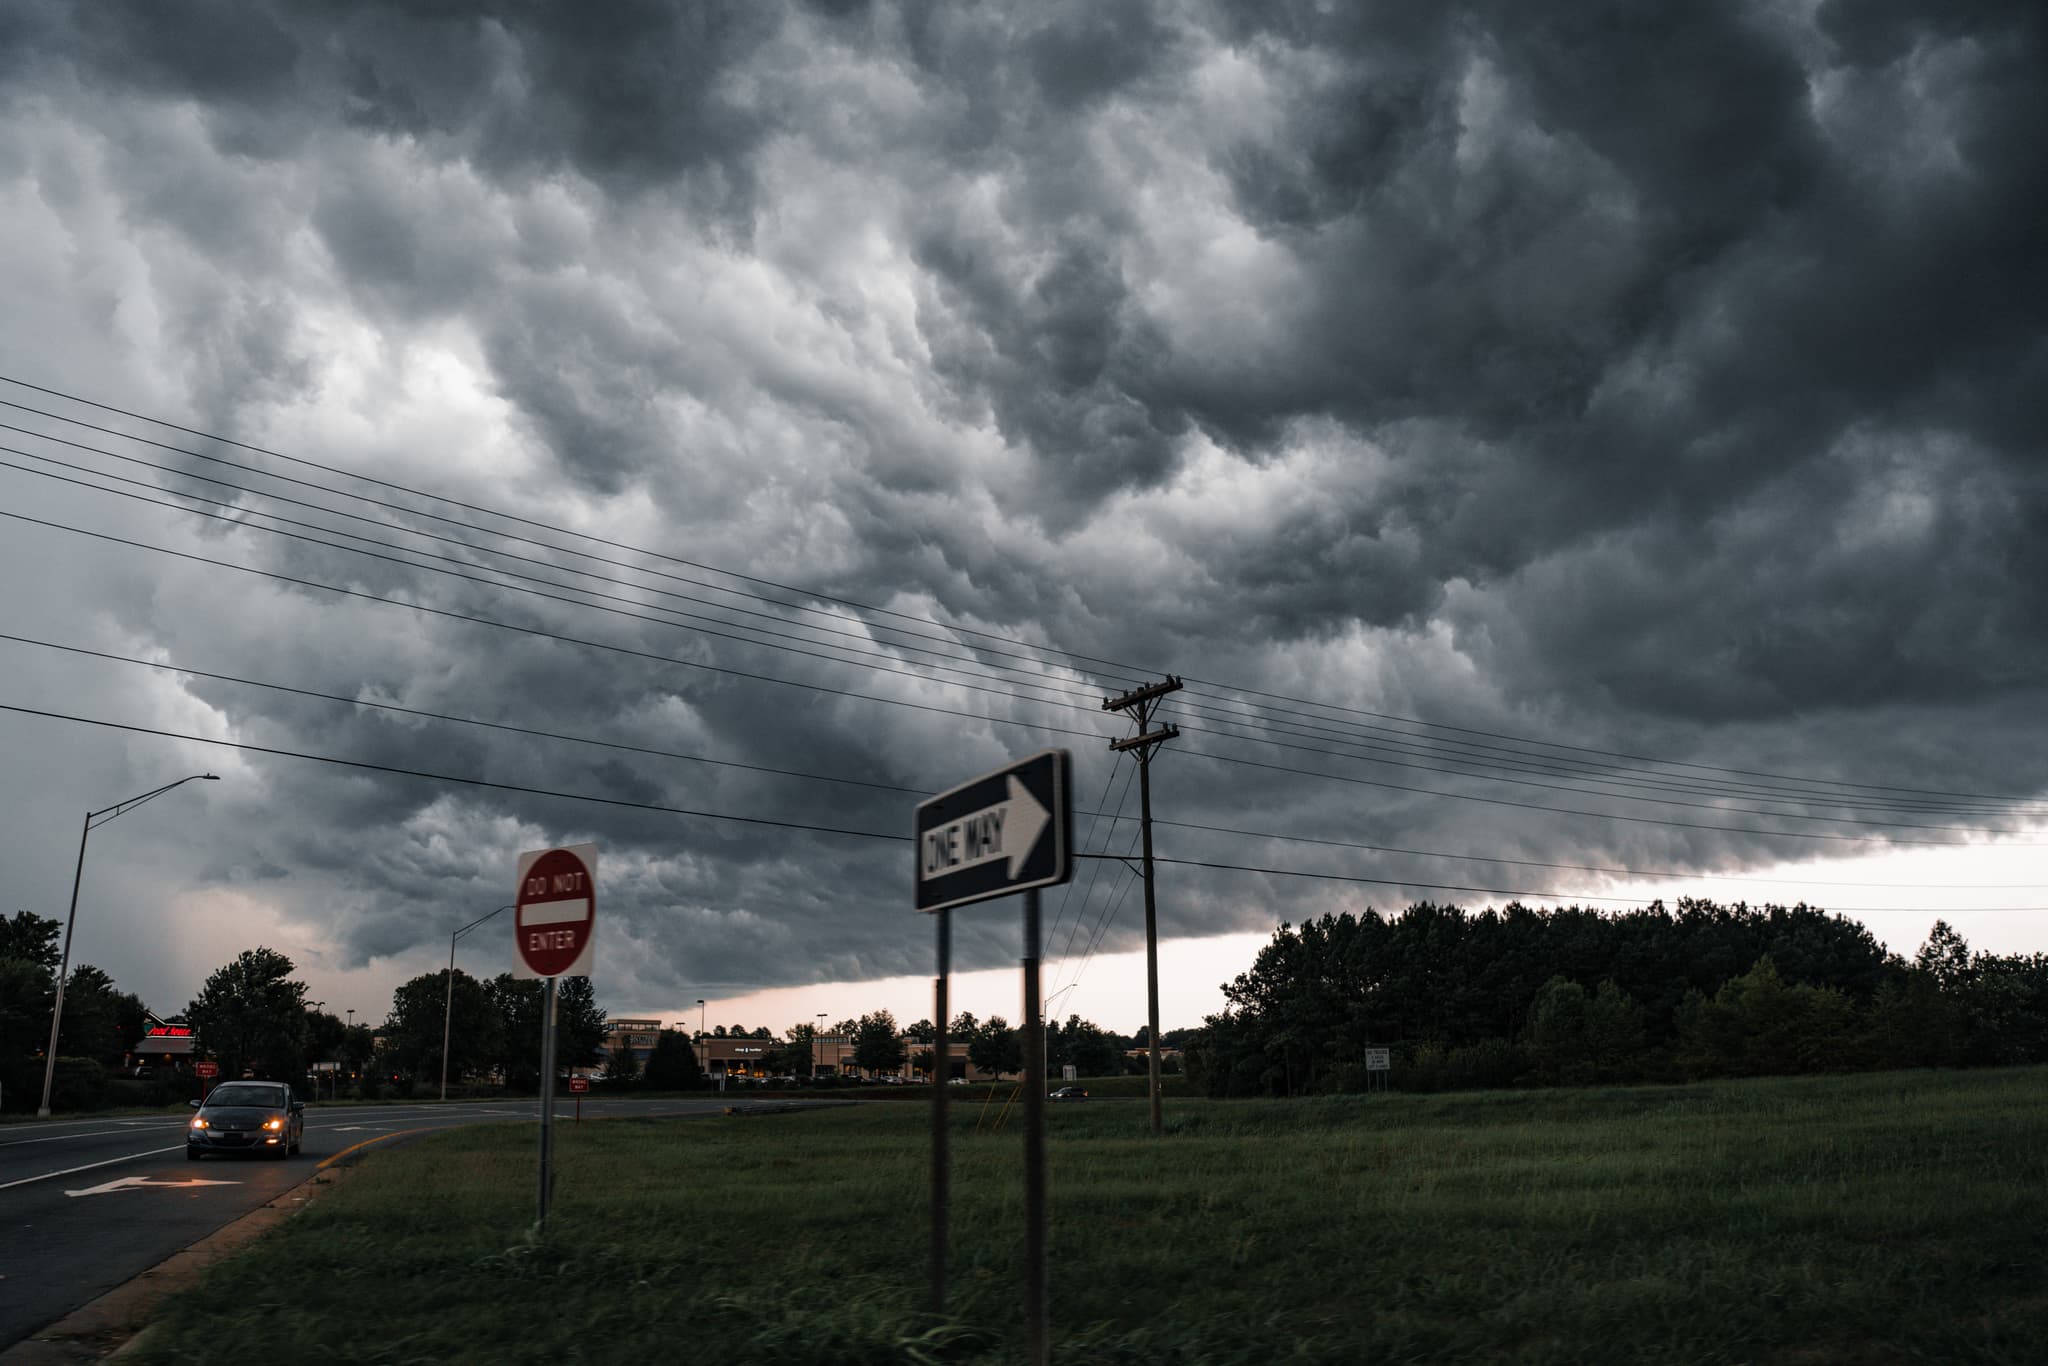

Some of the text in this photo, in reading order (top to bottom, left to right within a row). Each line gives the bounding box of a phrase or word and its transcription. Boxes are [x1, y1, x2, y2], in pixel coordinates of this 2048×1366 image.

[927, 807, 1008, 873] ONE WAY
[527, 872, 584, 896] DO NOT
[530, 930, 575, 951] ENTER
